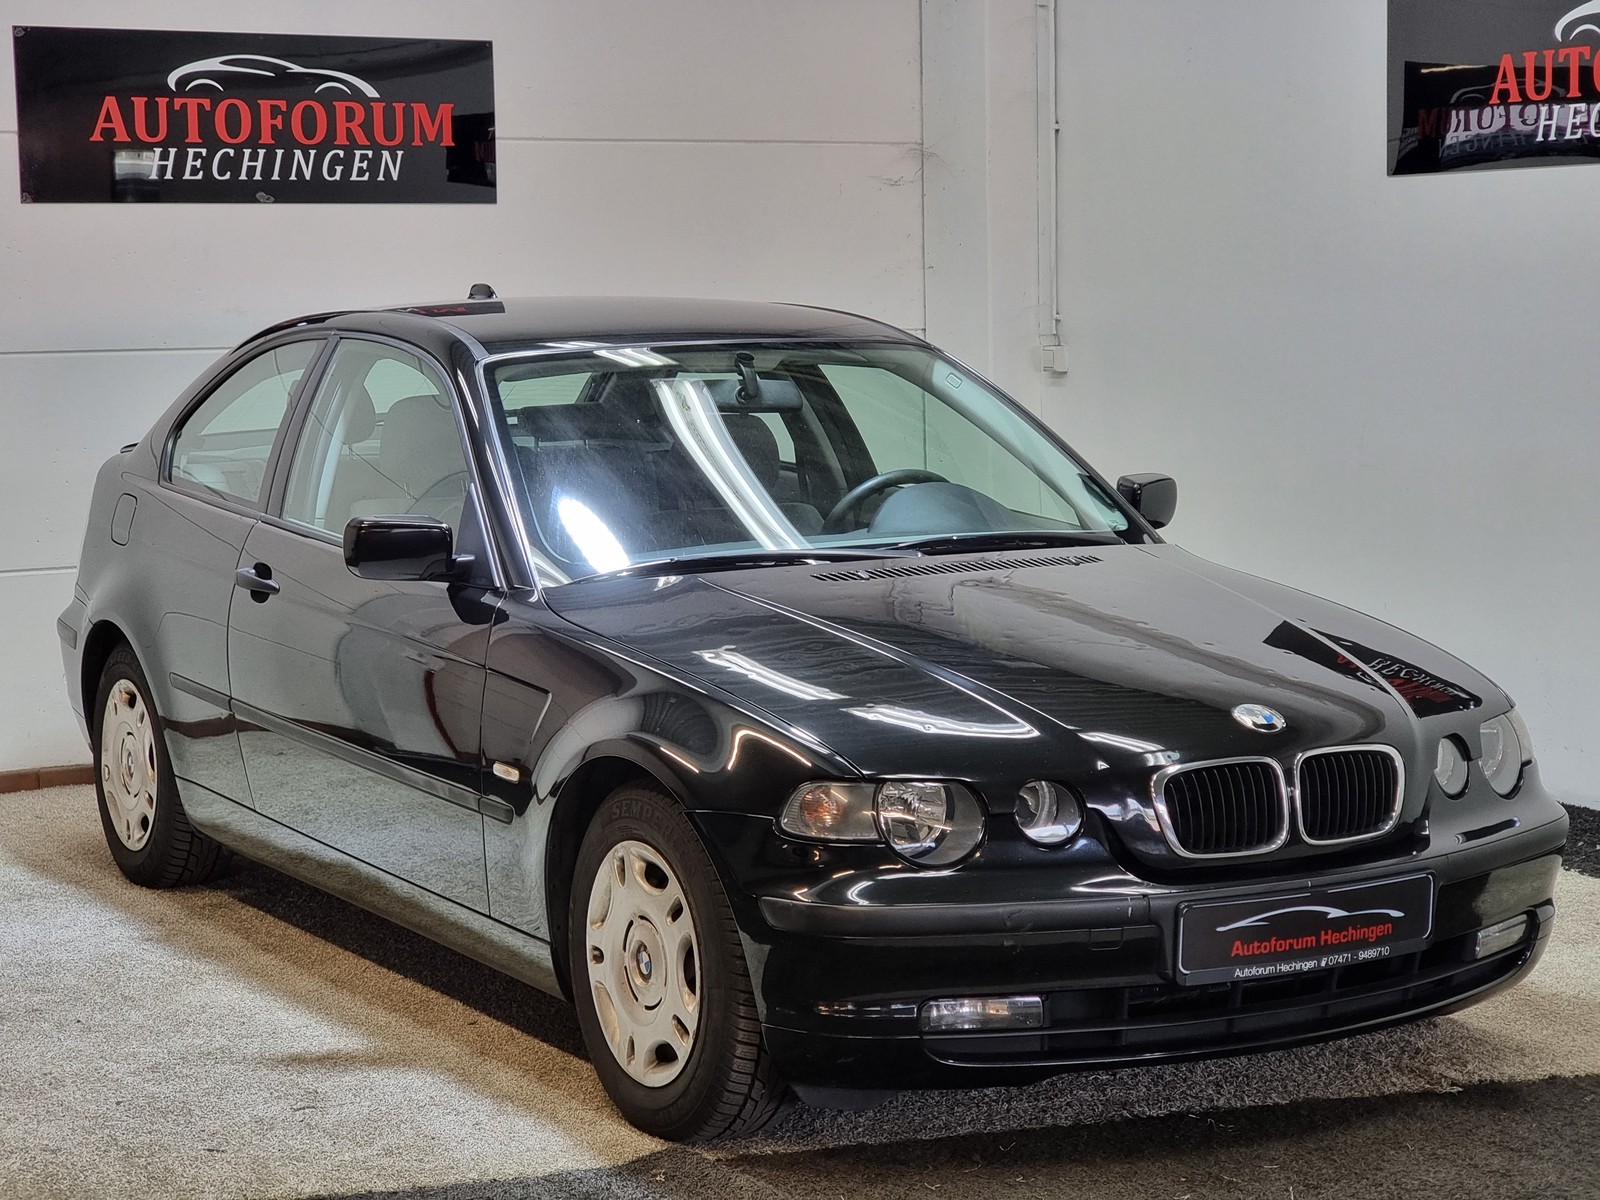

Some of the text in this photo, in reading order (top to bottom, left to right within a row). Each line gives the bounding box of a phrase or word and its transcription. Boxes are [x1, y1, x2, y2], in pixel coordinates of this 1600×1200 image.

[1489, 46, 1600, 105] AUT
[89, 95, 455, 147] AUTOFORUM
[148, 147, 404, 182] HECHINGEN
[1231, 922, 1393, 957] Autoforum Hechingen
[1234, 963, 1276, 978] Autoforum
[1276, 960, 1318, 973] Hechingen
[1328, 953, 1351, 966] 07471
[1358, 946, 1390, 961] 9489710
